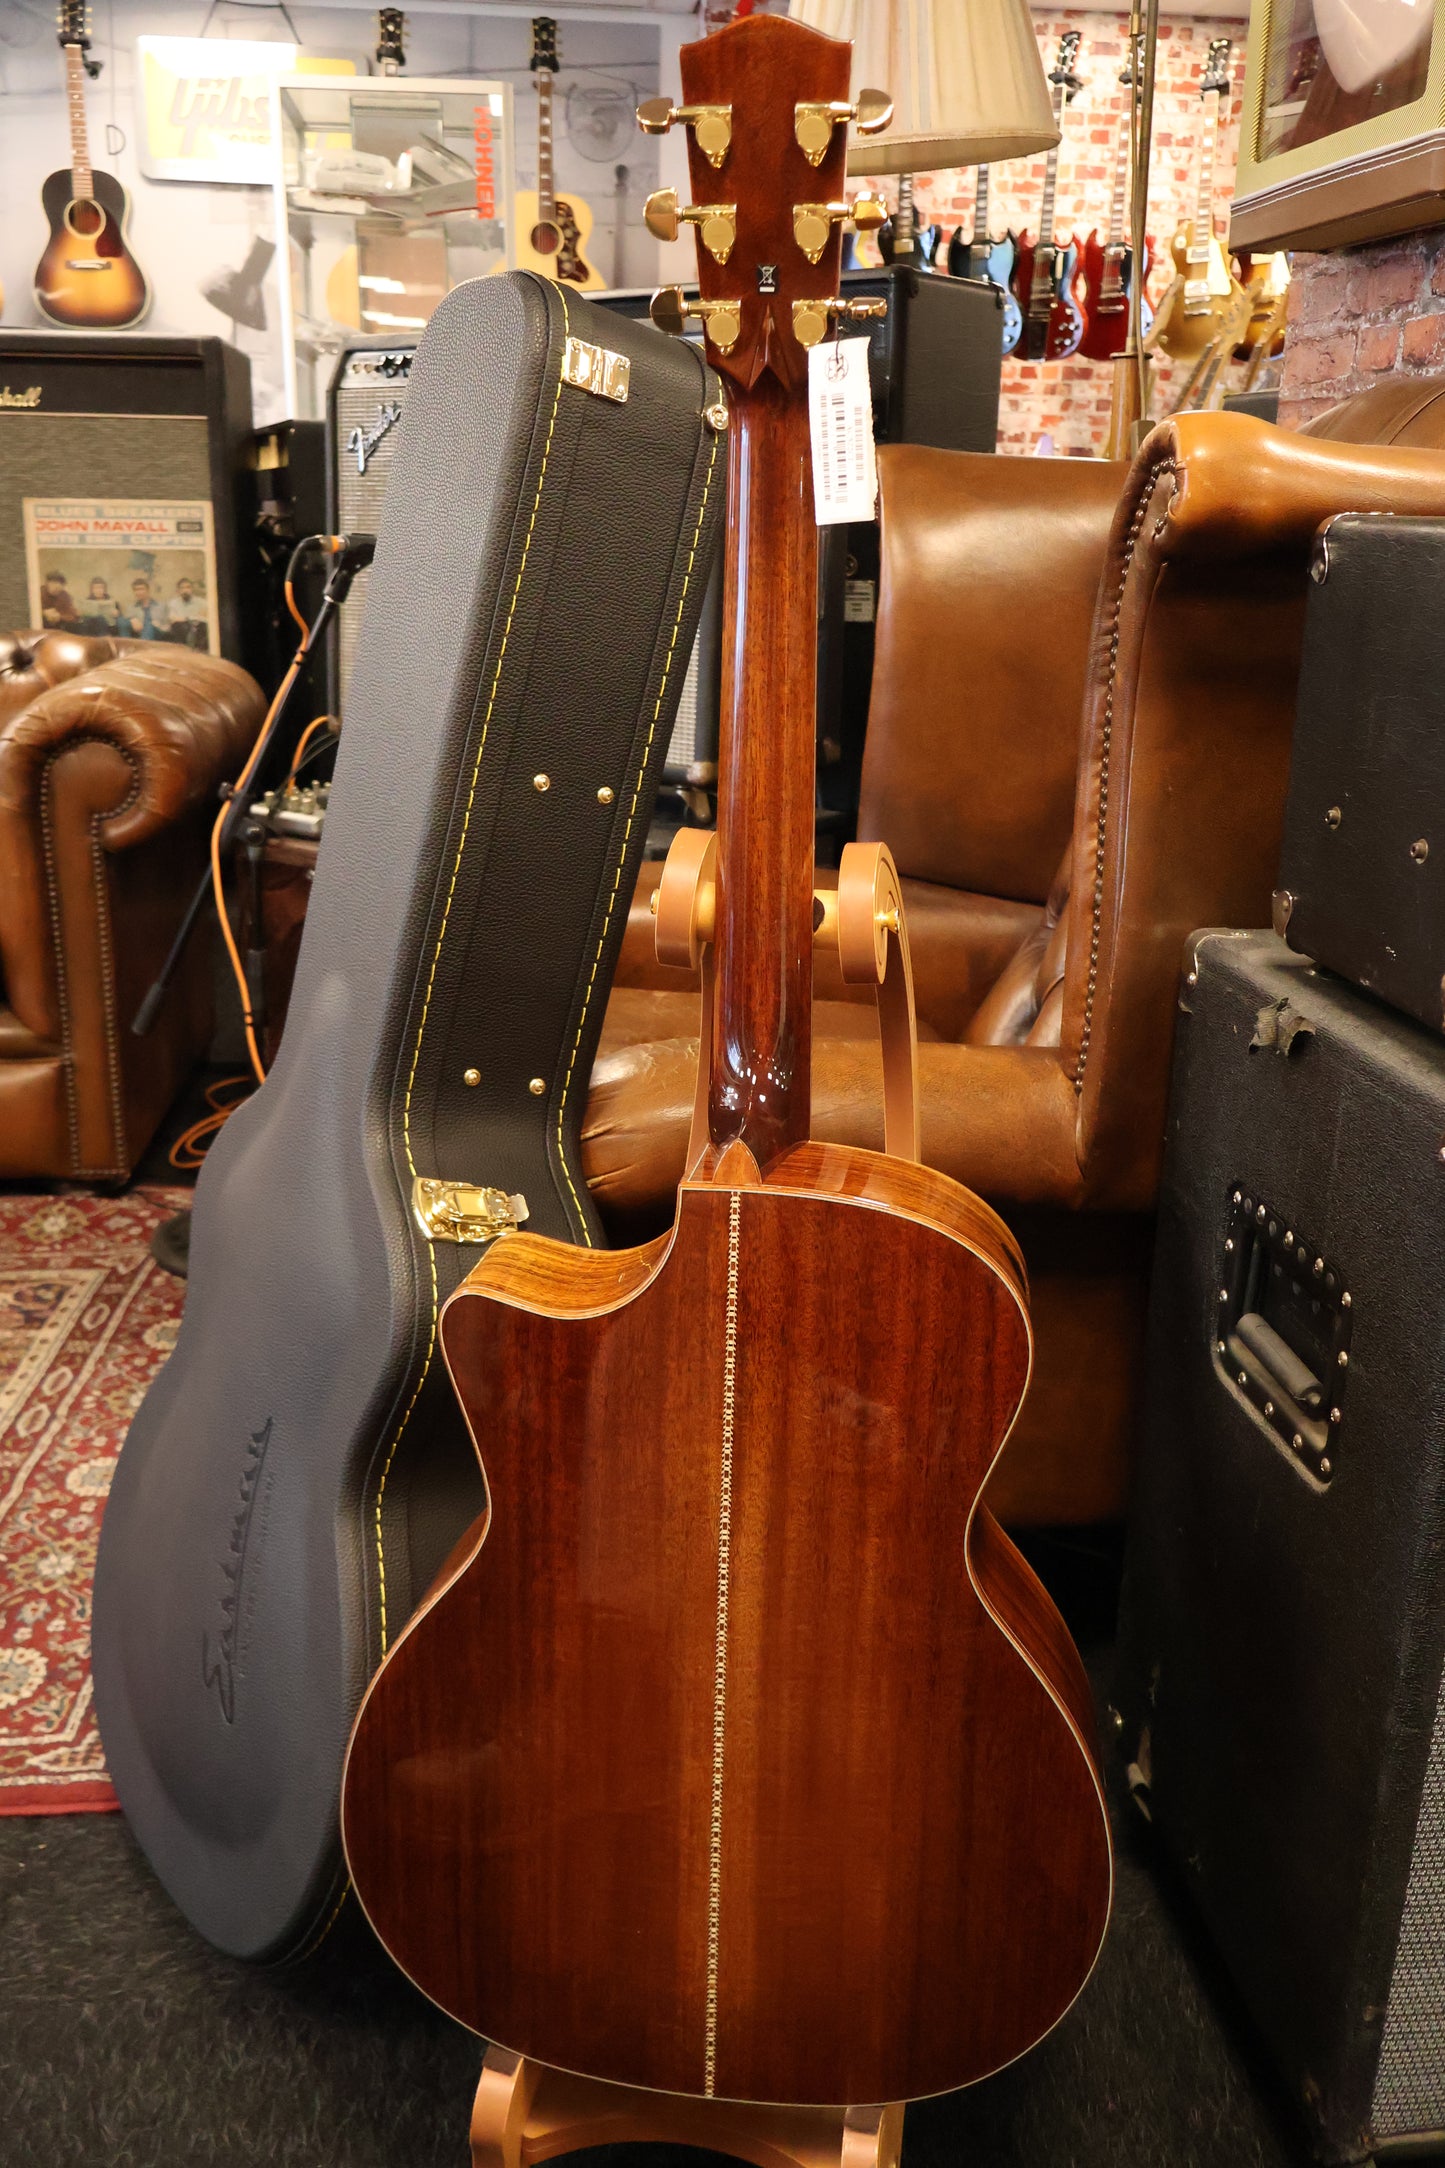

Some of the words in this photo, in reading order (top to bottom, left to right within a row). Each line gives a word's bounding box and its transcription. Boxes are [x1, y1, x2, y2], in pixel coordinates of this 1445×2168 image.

[473, 106, 495, 220] HOHNER
[36, 520, 88, 532] JOHN
[93, 520, 168, 533] MAYALL
